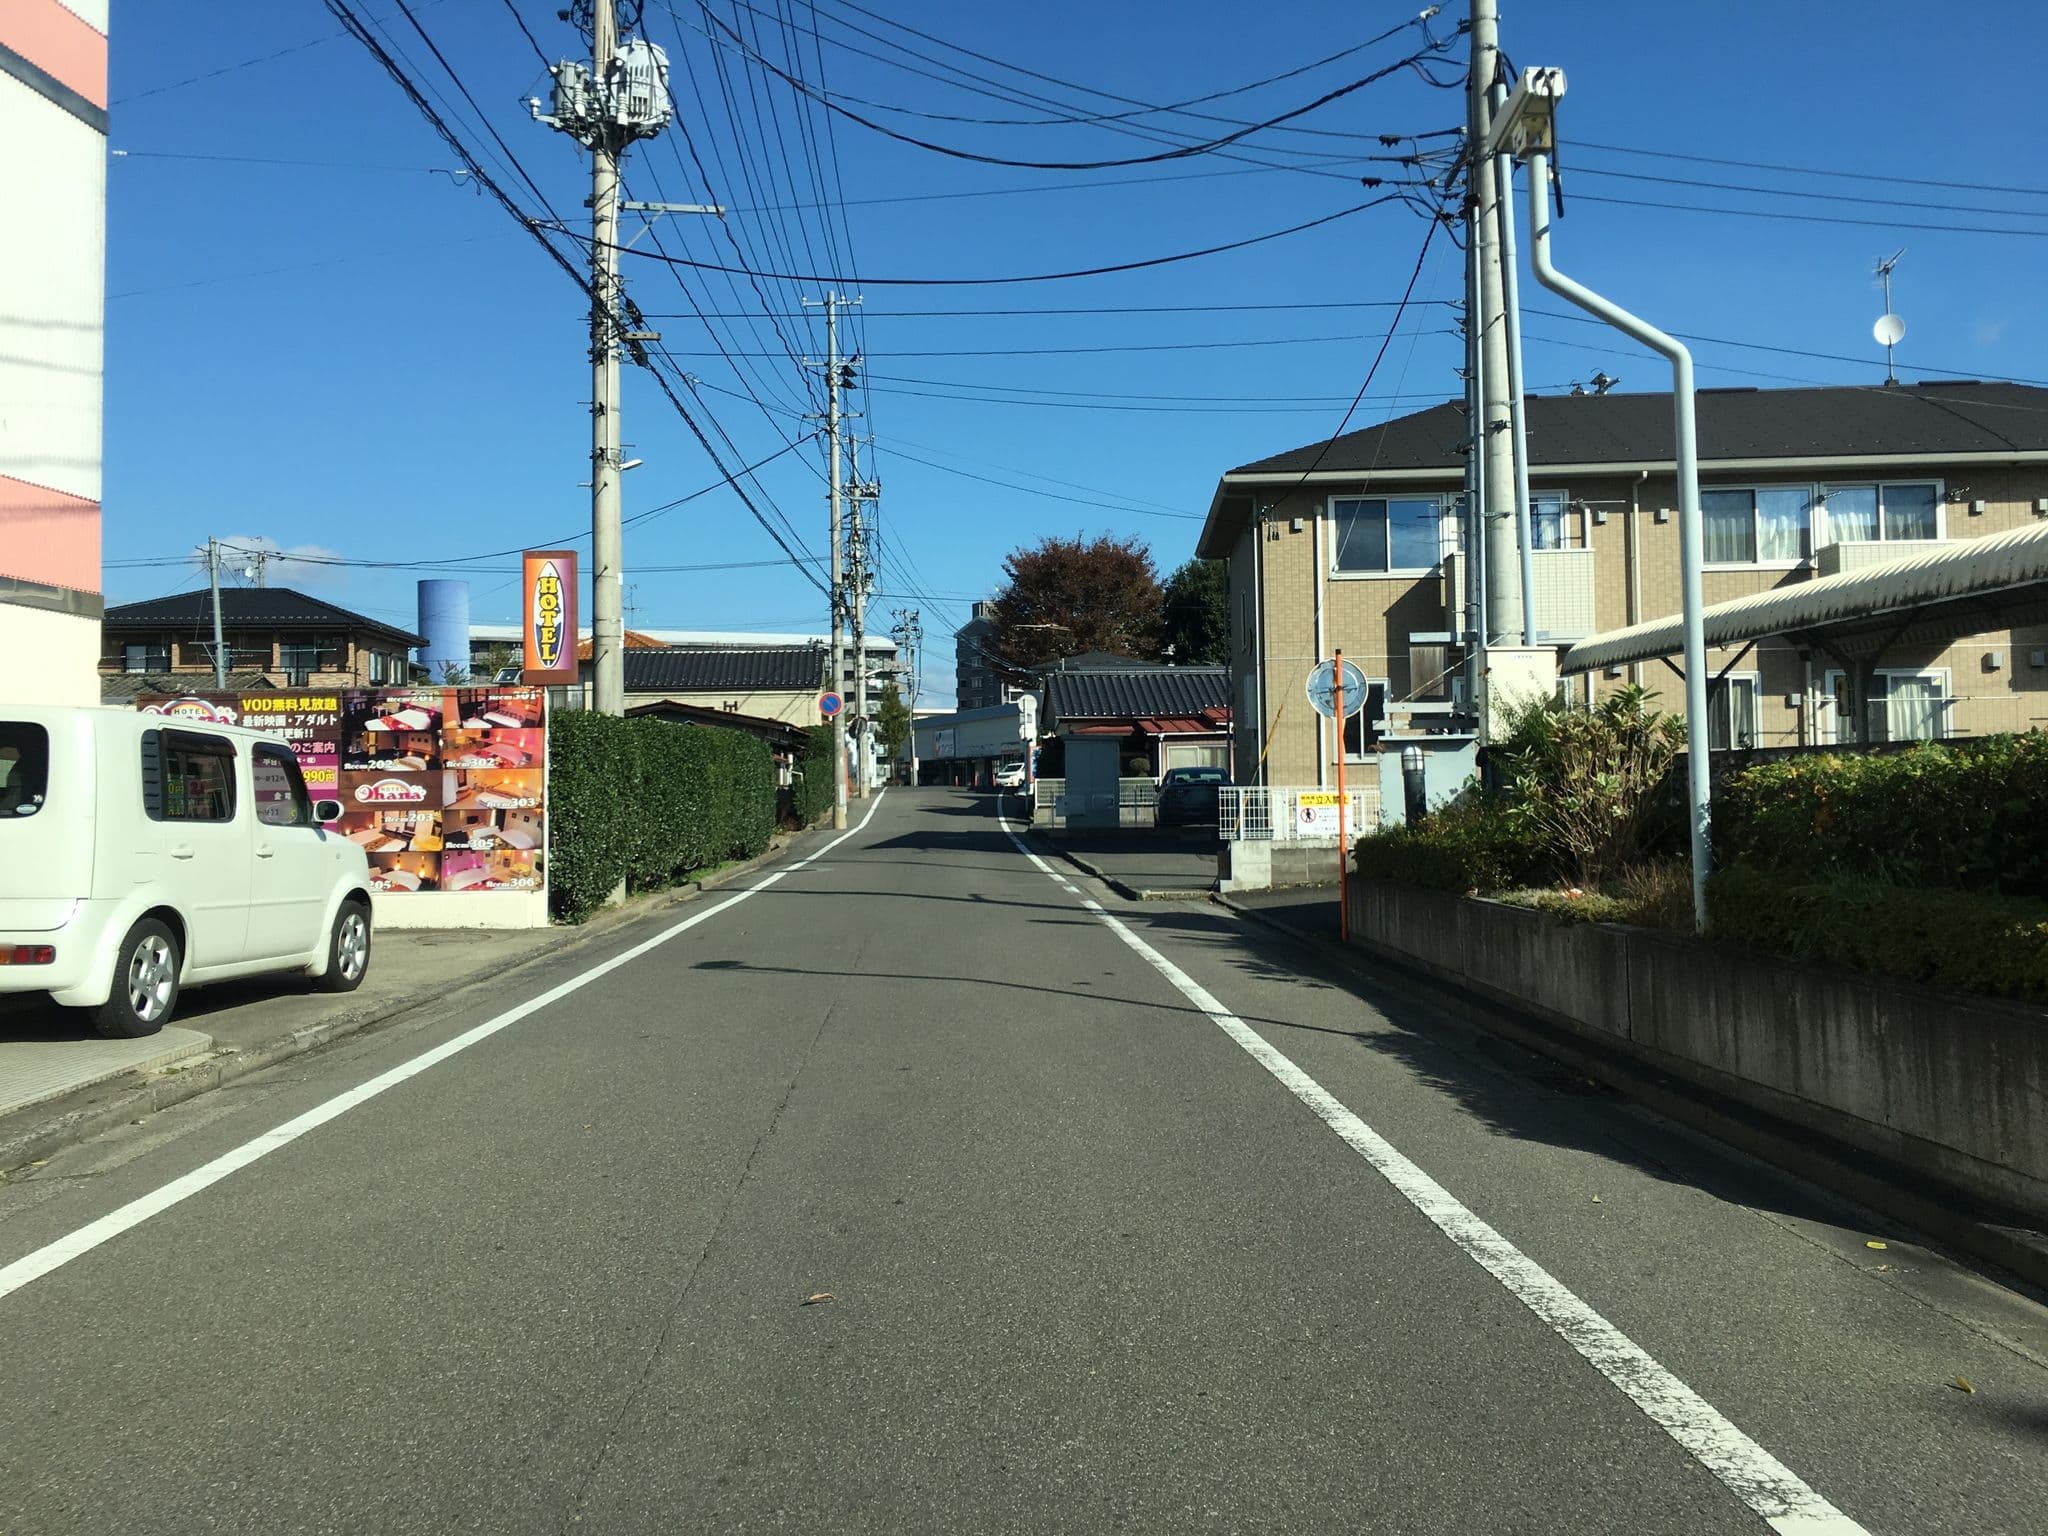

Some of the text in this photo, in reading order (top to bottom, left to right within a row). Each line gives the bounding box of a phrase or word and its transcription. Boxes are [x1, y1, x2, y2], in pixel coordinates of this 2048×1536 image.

[539, 577, 558, 660] HOTEL
[512, 690, 536, 700] 301
[242, 697, 338, 712] VOD無料見放題
[242, 714, 338, 727] 最新映画・アダルト
[368, 759, 394, 769] 202
[469, 758, 496, 768] 302
[357, 786, 421, 800] Ohana
[512, 798, 536, 807] 303
[408, 813, 434, 823] 203
[469, 838, 495, 848] 305
[511, 877, 535, 887] 306
